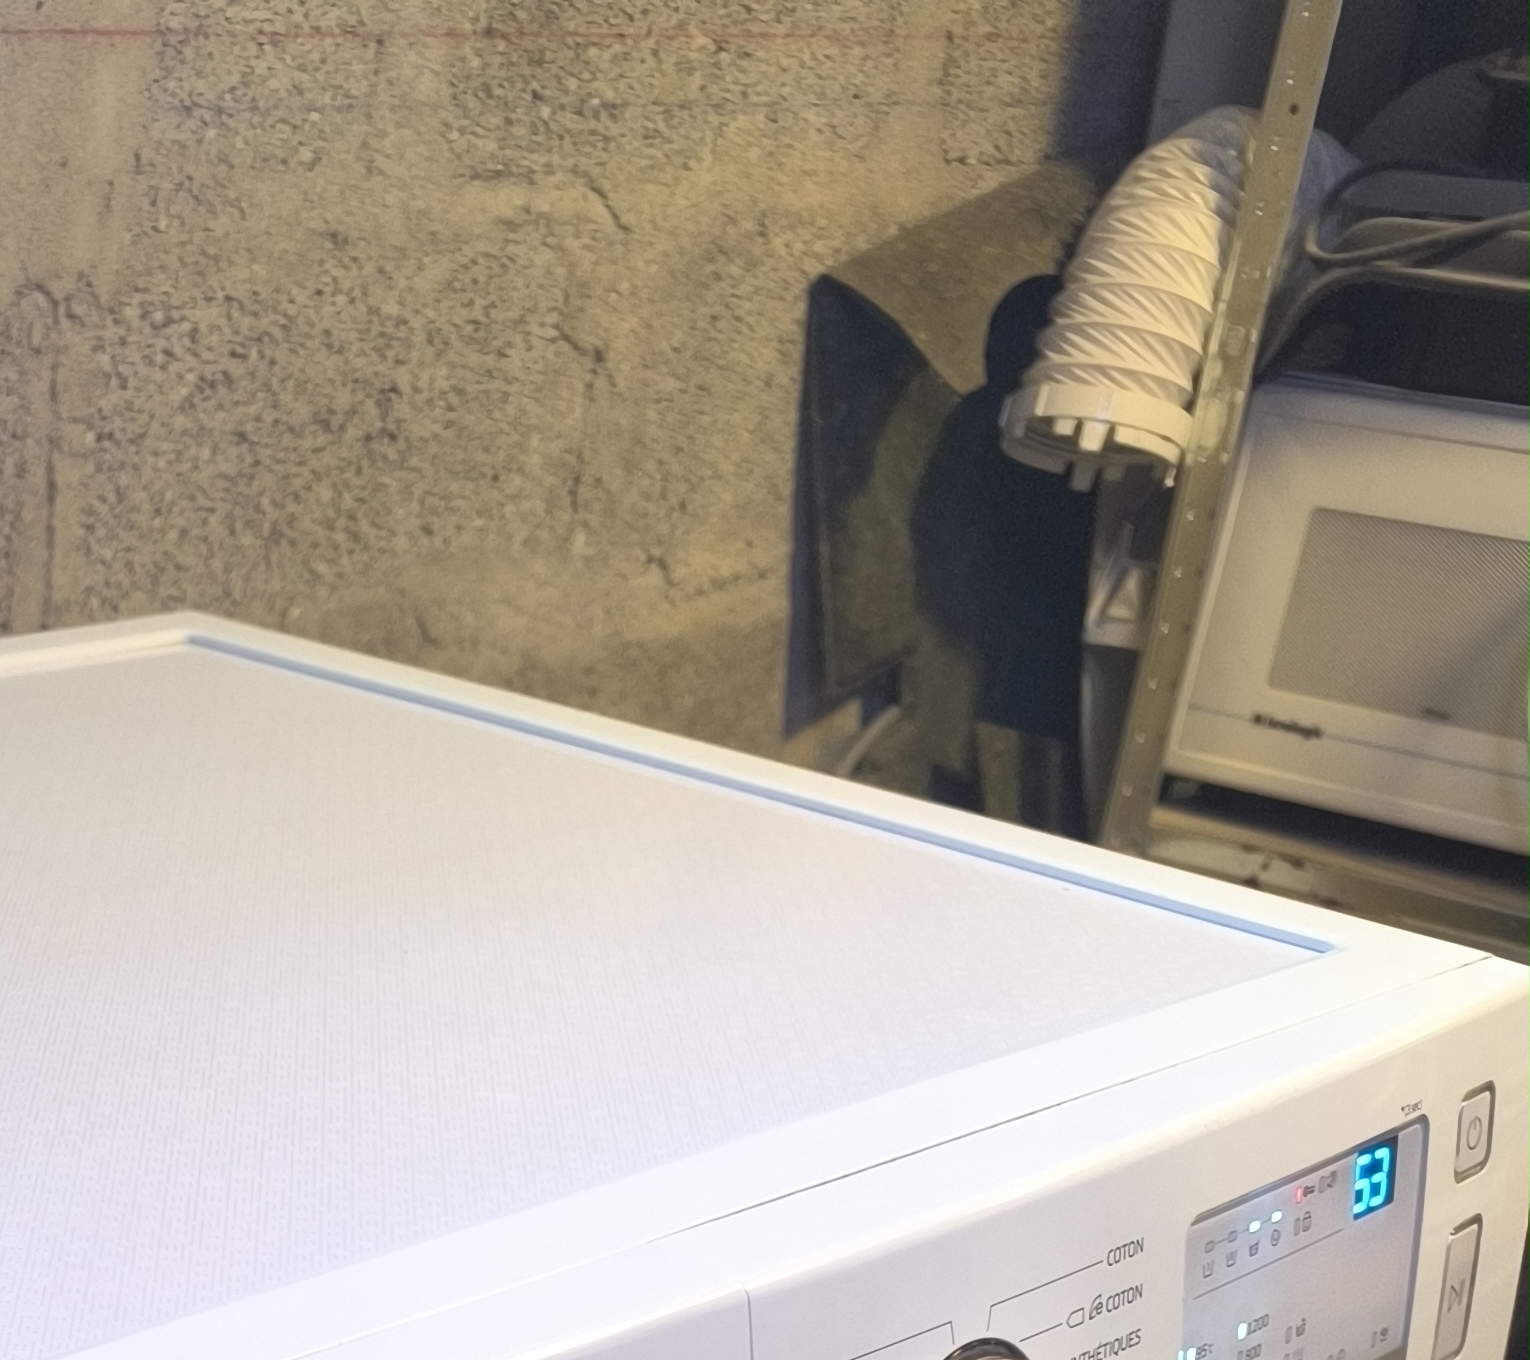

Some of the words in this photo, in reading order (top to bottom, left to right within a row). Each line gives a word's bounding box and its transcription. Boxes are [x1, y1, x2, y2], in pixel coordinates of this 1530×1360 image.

[1352, 1147, 1390, 1213] 53
[1106, 1237, 1145, 1266] COTON
[1105, 1284, 1143, 1313] COTON
